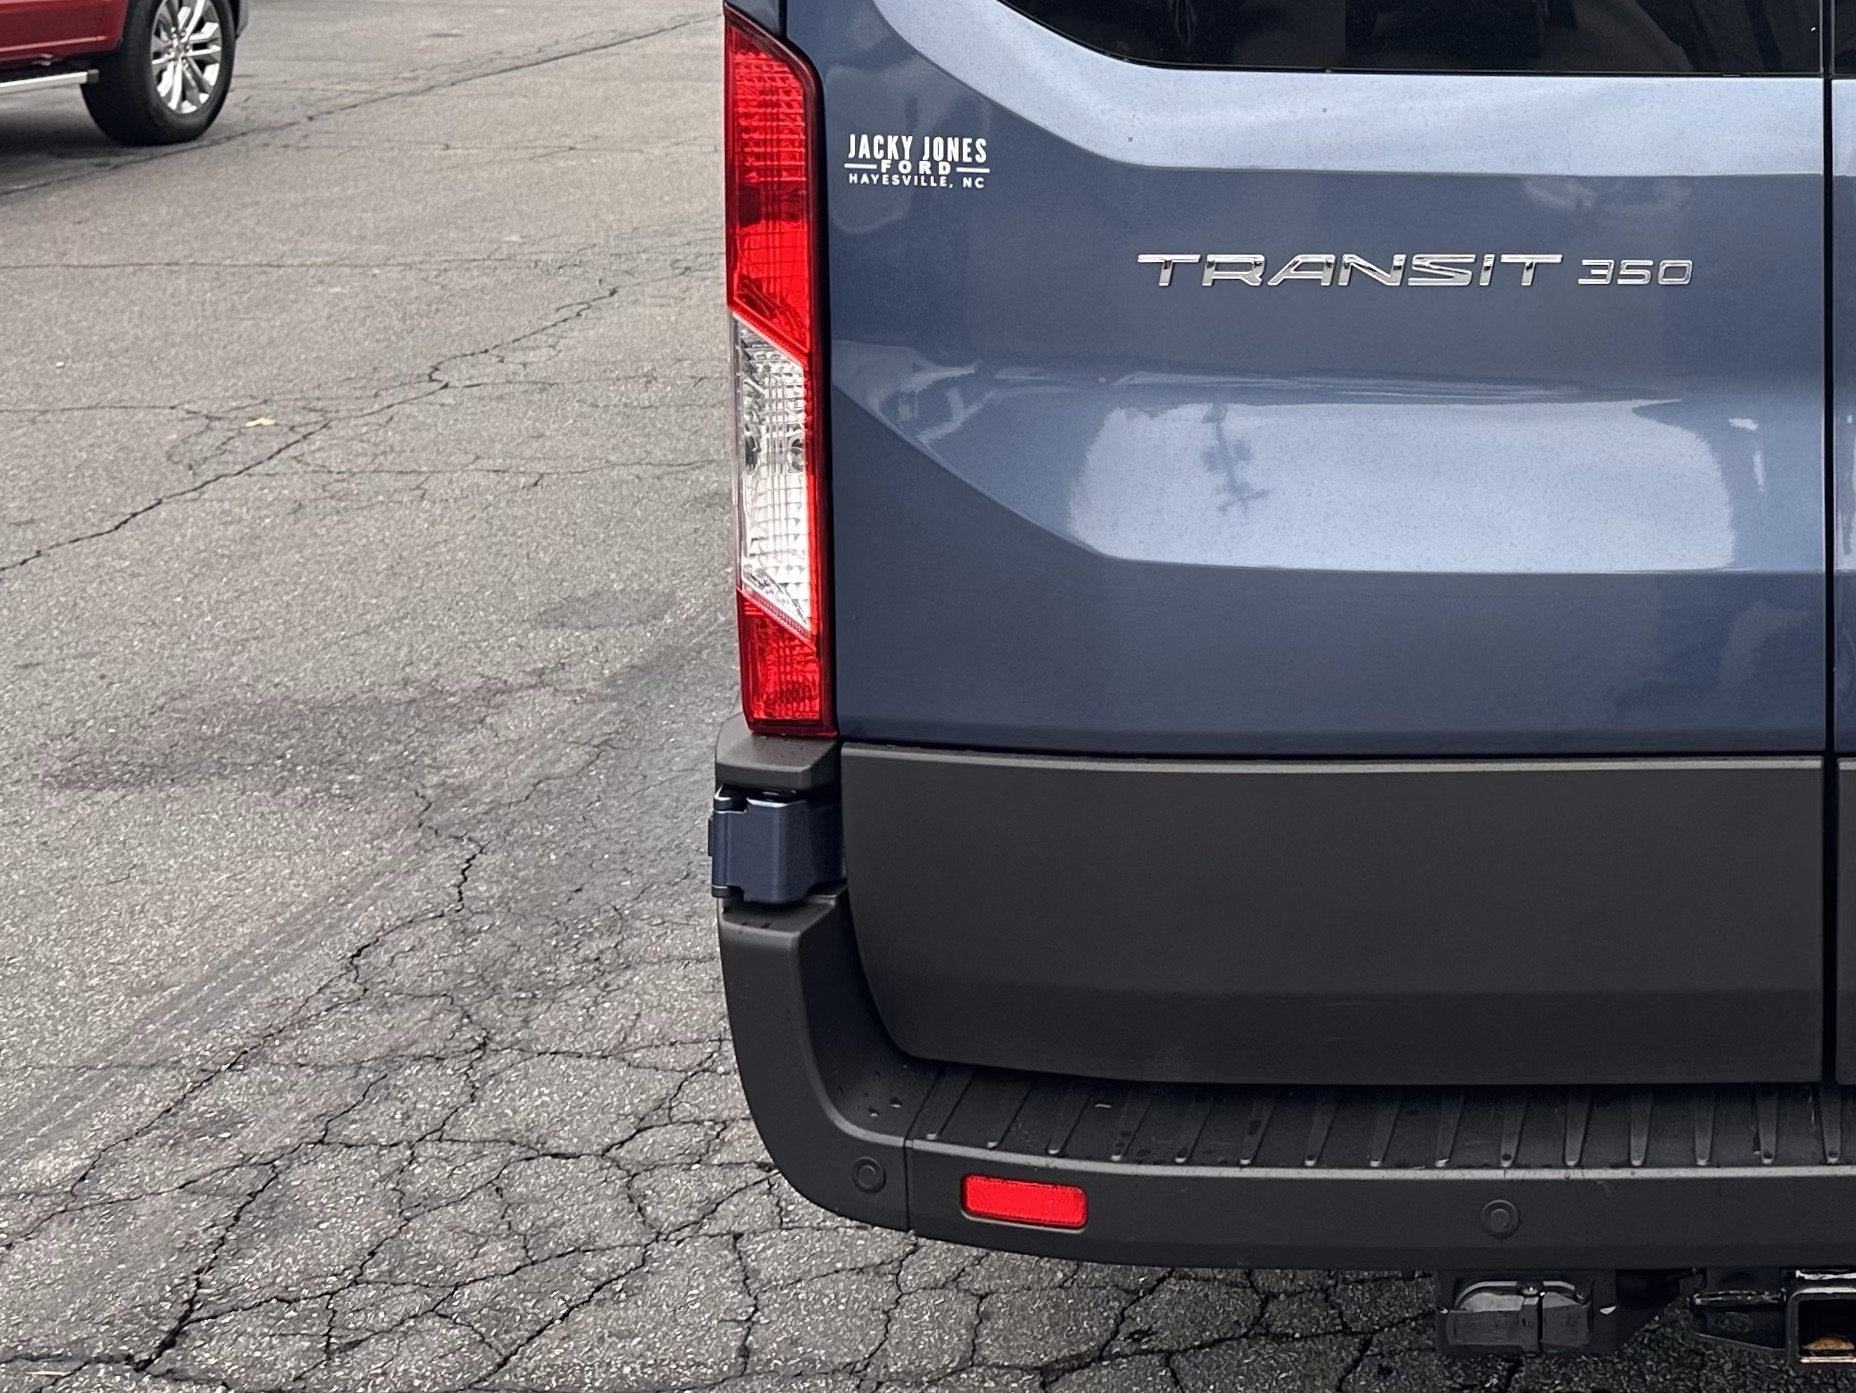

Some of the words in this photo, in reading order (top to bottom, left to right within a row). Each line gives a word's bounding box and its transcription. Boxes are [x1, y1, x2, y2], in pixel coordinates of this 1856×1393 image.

[848, 134, 913, 161] JACKY
[922, 136, 987, 163] JONES
[881, 159, 951, 175] FORD
[849, 173, 954, 189] HAYESVILLE,
[962, 177, 985, 189] NC
[1137, 253, 1563, 287] TRANSIT
[1577, 259, 1693, 286] 350
